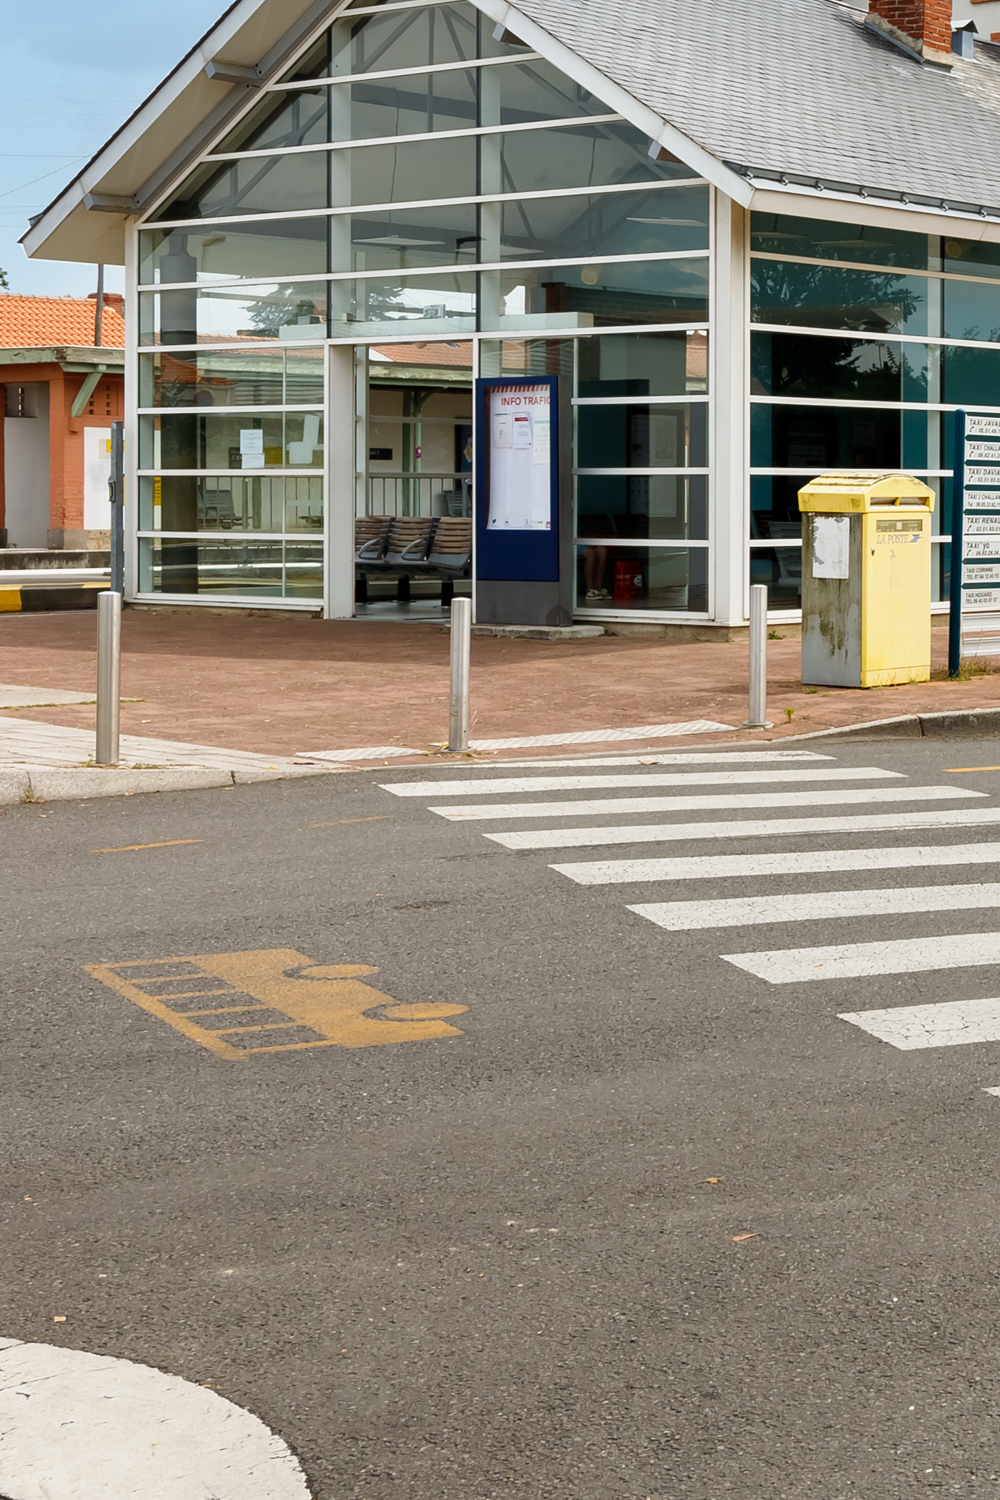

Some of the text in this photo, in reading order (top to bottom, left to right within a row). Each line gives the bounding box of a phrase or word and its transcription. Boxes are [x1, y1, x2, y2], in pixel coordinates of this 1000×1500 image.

[501, 397, 521, 405] INFO
[876, 534, 909, 544] LA POSTE
